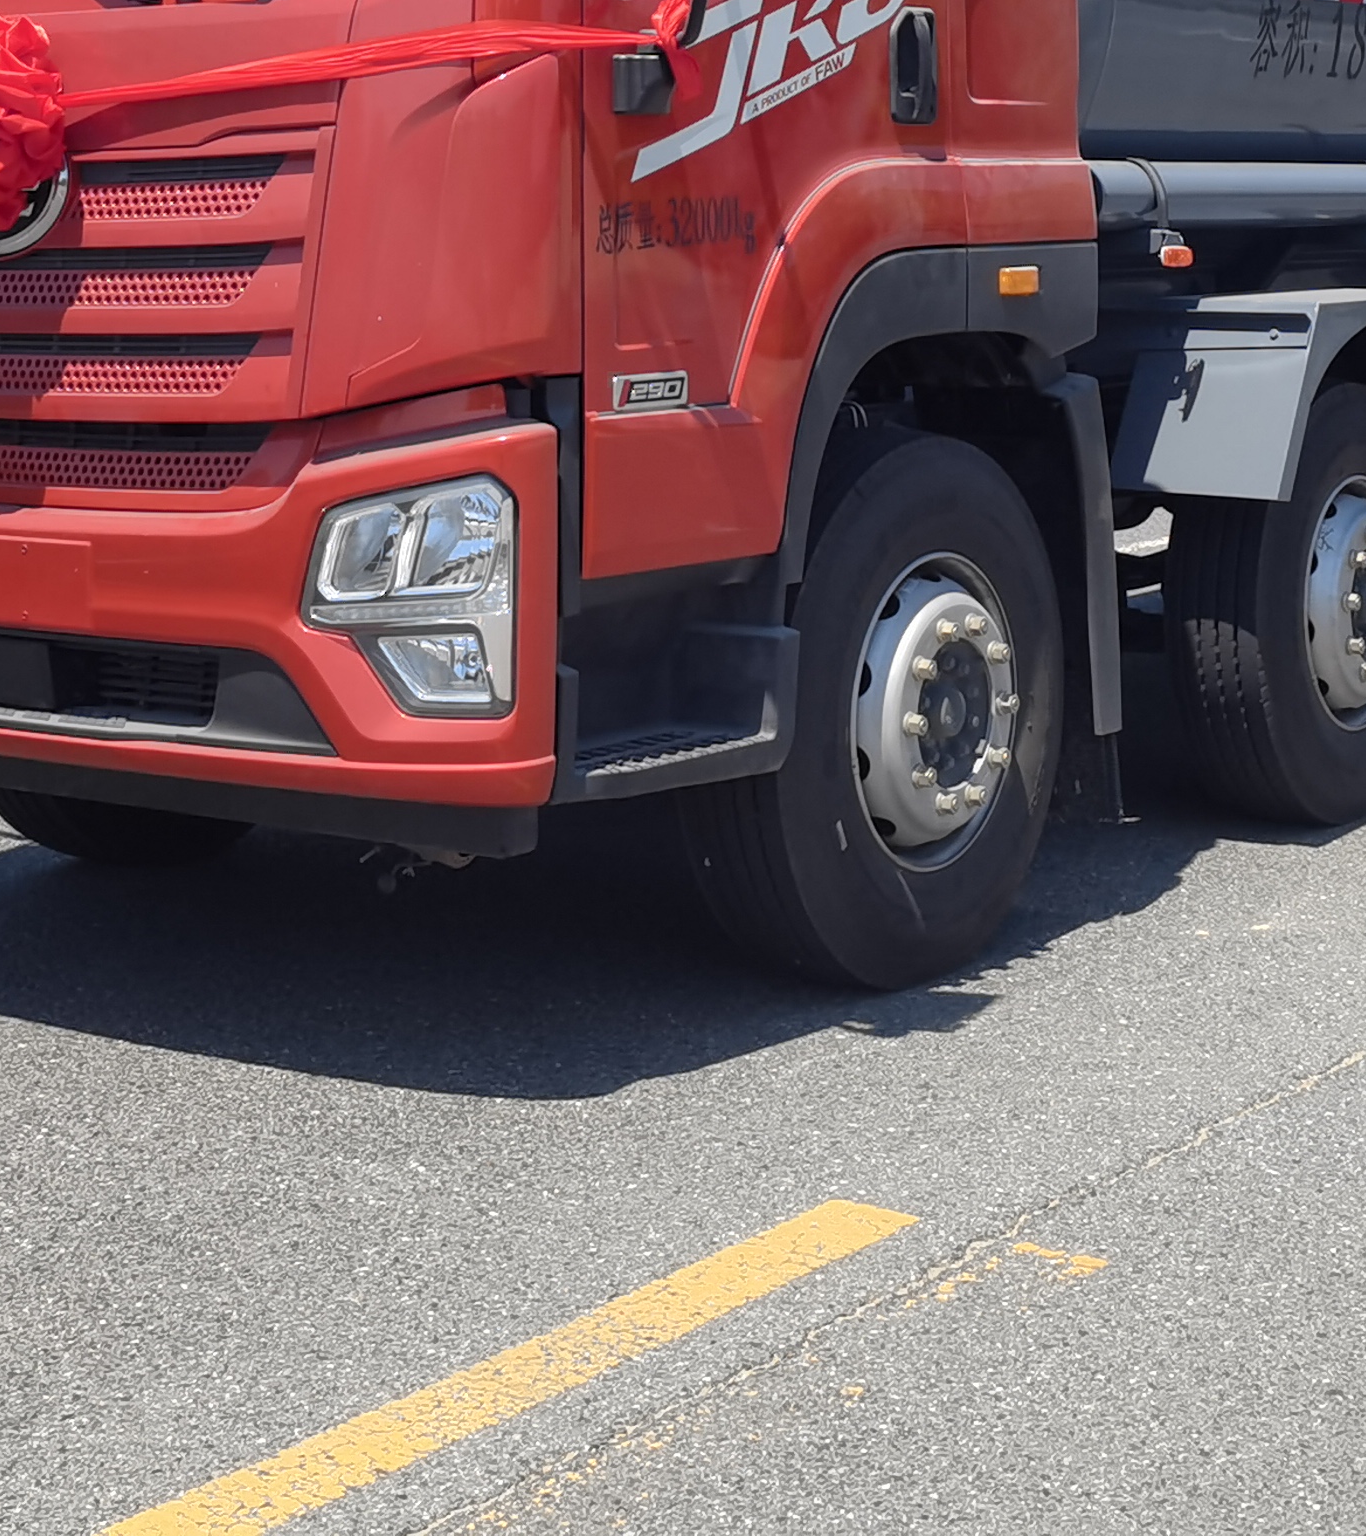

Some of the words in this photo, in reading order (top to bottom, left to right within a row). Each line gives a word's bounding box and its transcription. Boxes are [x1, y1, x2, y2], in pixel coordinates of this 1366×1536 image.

[751, 103, 760, 114] A
[761, 79, 800, 109] PRODUCT
[800, 72, 812, 87] OF
[814, 52, 846, 81] FAW
